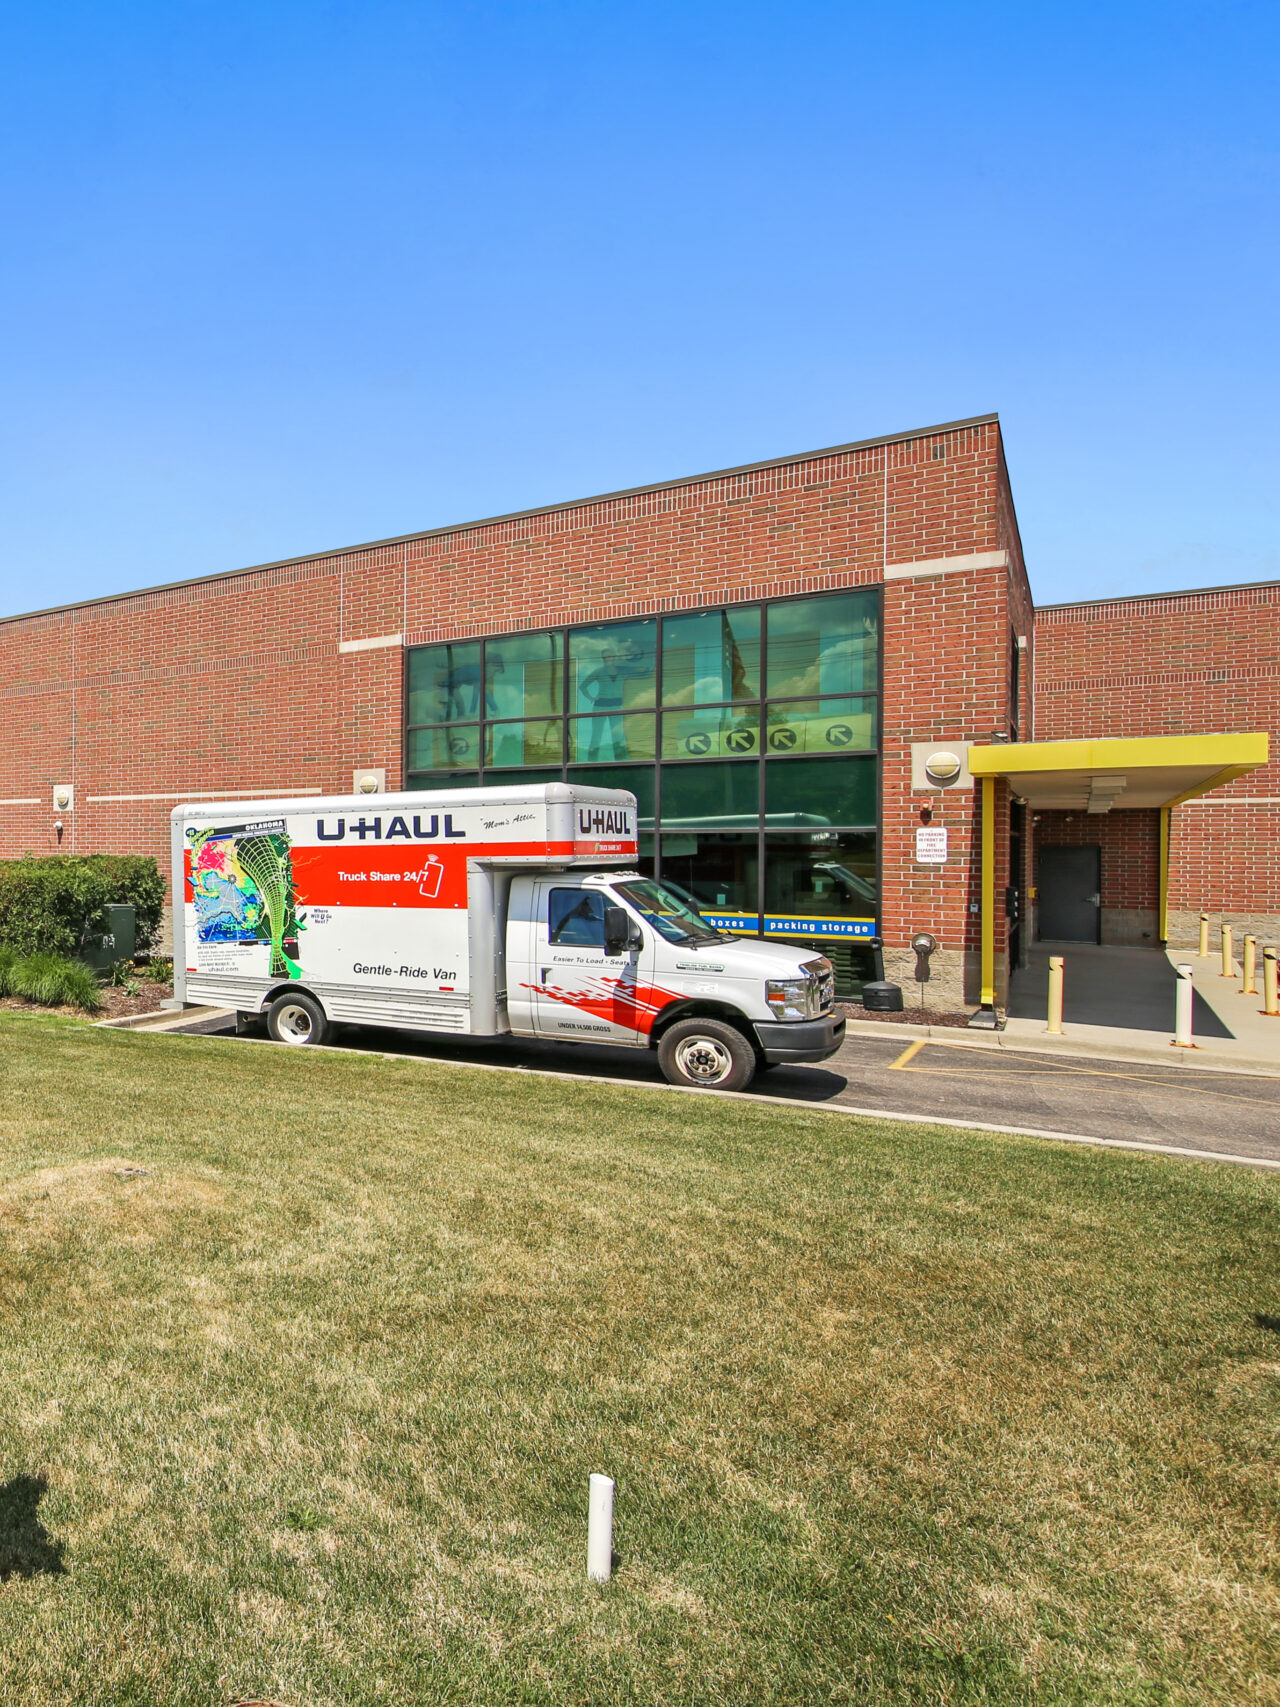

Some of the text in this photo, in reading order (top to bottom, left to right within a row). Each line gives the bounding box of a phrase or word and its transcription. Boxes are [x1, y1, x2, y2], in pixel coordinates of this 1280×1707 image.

[245, 820, 284, 831] OKLAHOMA
[338, 870, 429, 883] Truck Share 24/7
[710, 918, 744, 928] boxes
[770, 921, 868, 934] packing storage
[610, 958, 630, 966] Seats
[353, 963, 457, 980] Gentle-Ride Van
[558, 1022, 576, 1030] UNDER
[593, 1024, 611, 1033] GROSS
